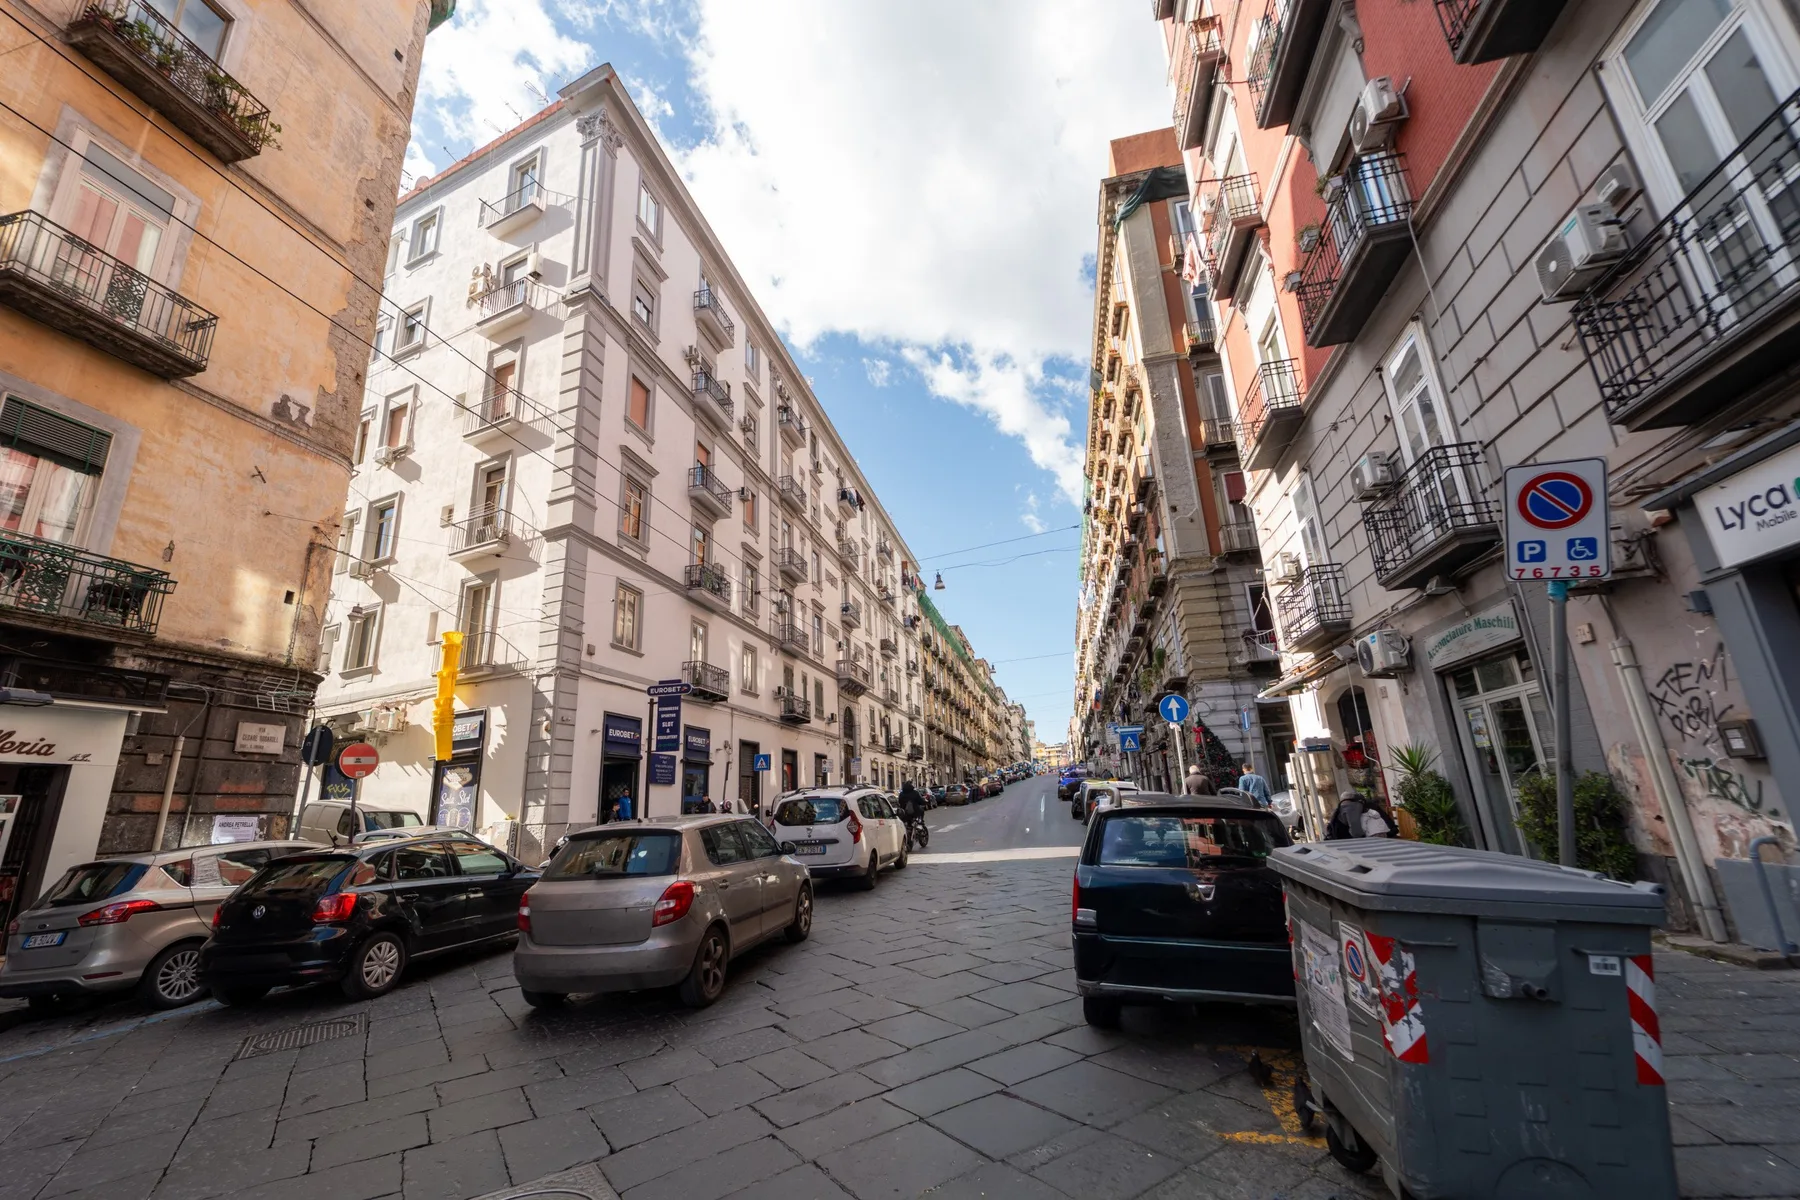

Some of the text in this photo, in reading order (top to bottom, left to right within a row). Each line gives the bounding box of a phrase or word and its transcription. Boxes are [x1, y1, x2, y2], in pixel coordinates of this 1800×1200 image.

[1715, 483, 1792, 531] Lyca
[1756, 510, 1798, 532] Mobile
[1523, 543, 1542, 560] P
[1427, 623, 1473, 661] Acconciature
[1472, 615, 1515, 630] Maschili
[650, 686, 681, 694] EUROBET
[0, 730, 56, 756] leria
[609, 728, 635, 739] EUROBET
[688, 735, 706, 745] EUROBET
